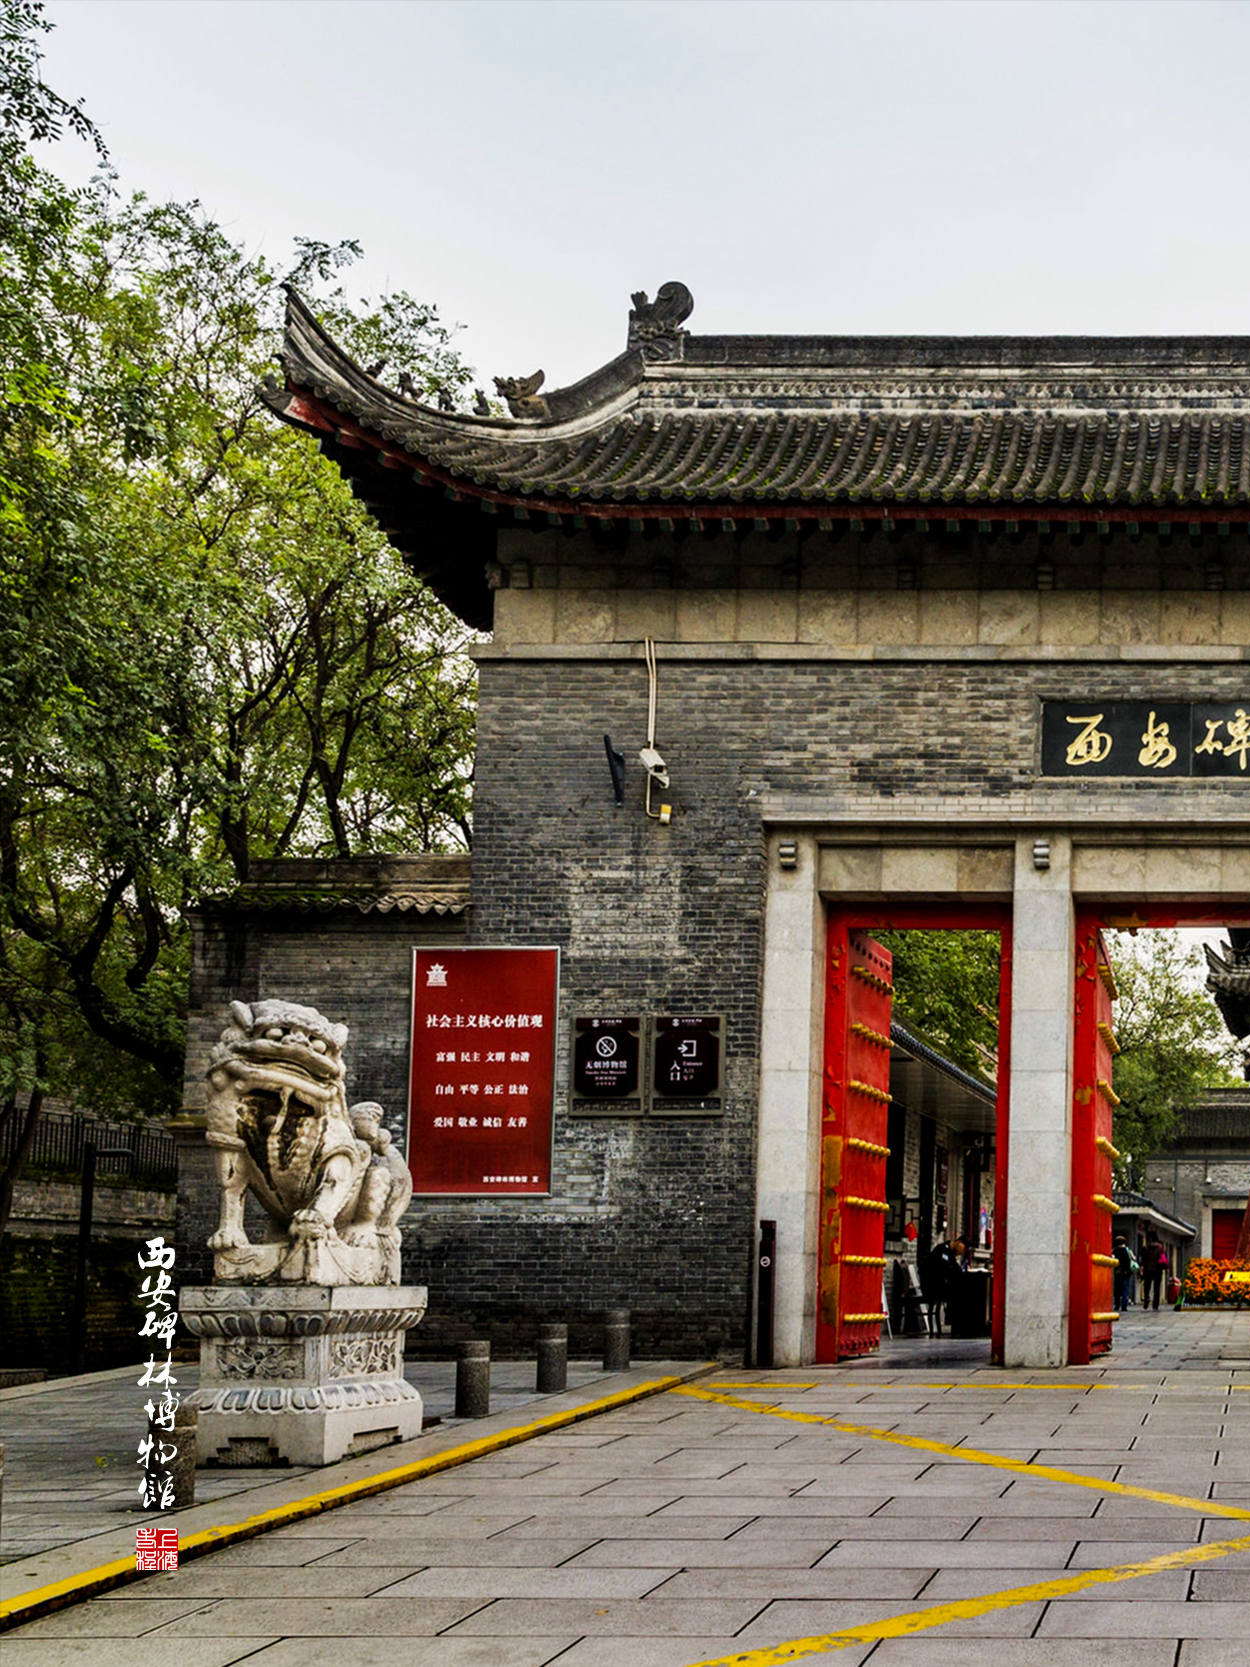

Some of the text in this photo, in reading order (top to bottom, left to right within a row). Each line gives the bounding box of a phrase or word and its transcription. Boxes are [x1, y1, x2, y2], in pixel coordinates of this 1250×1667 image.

[426, 1013, 543, 1029] 社会主义核心价值观
[436, 1051, 530, 1063] 富强 民主 文明 和谐
[435, 1084, 529, 1095] 自由 平等 公正 法治
[433, 1116, 454, 1128] 爱国
[457, 1116, 478, 1128] 敬业
[507, 1116, 527, 1128] 友善
